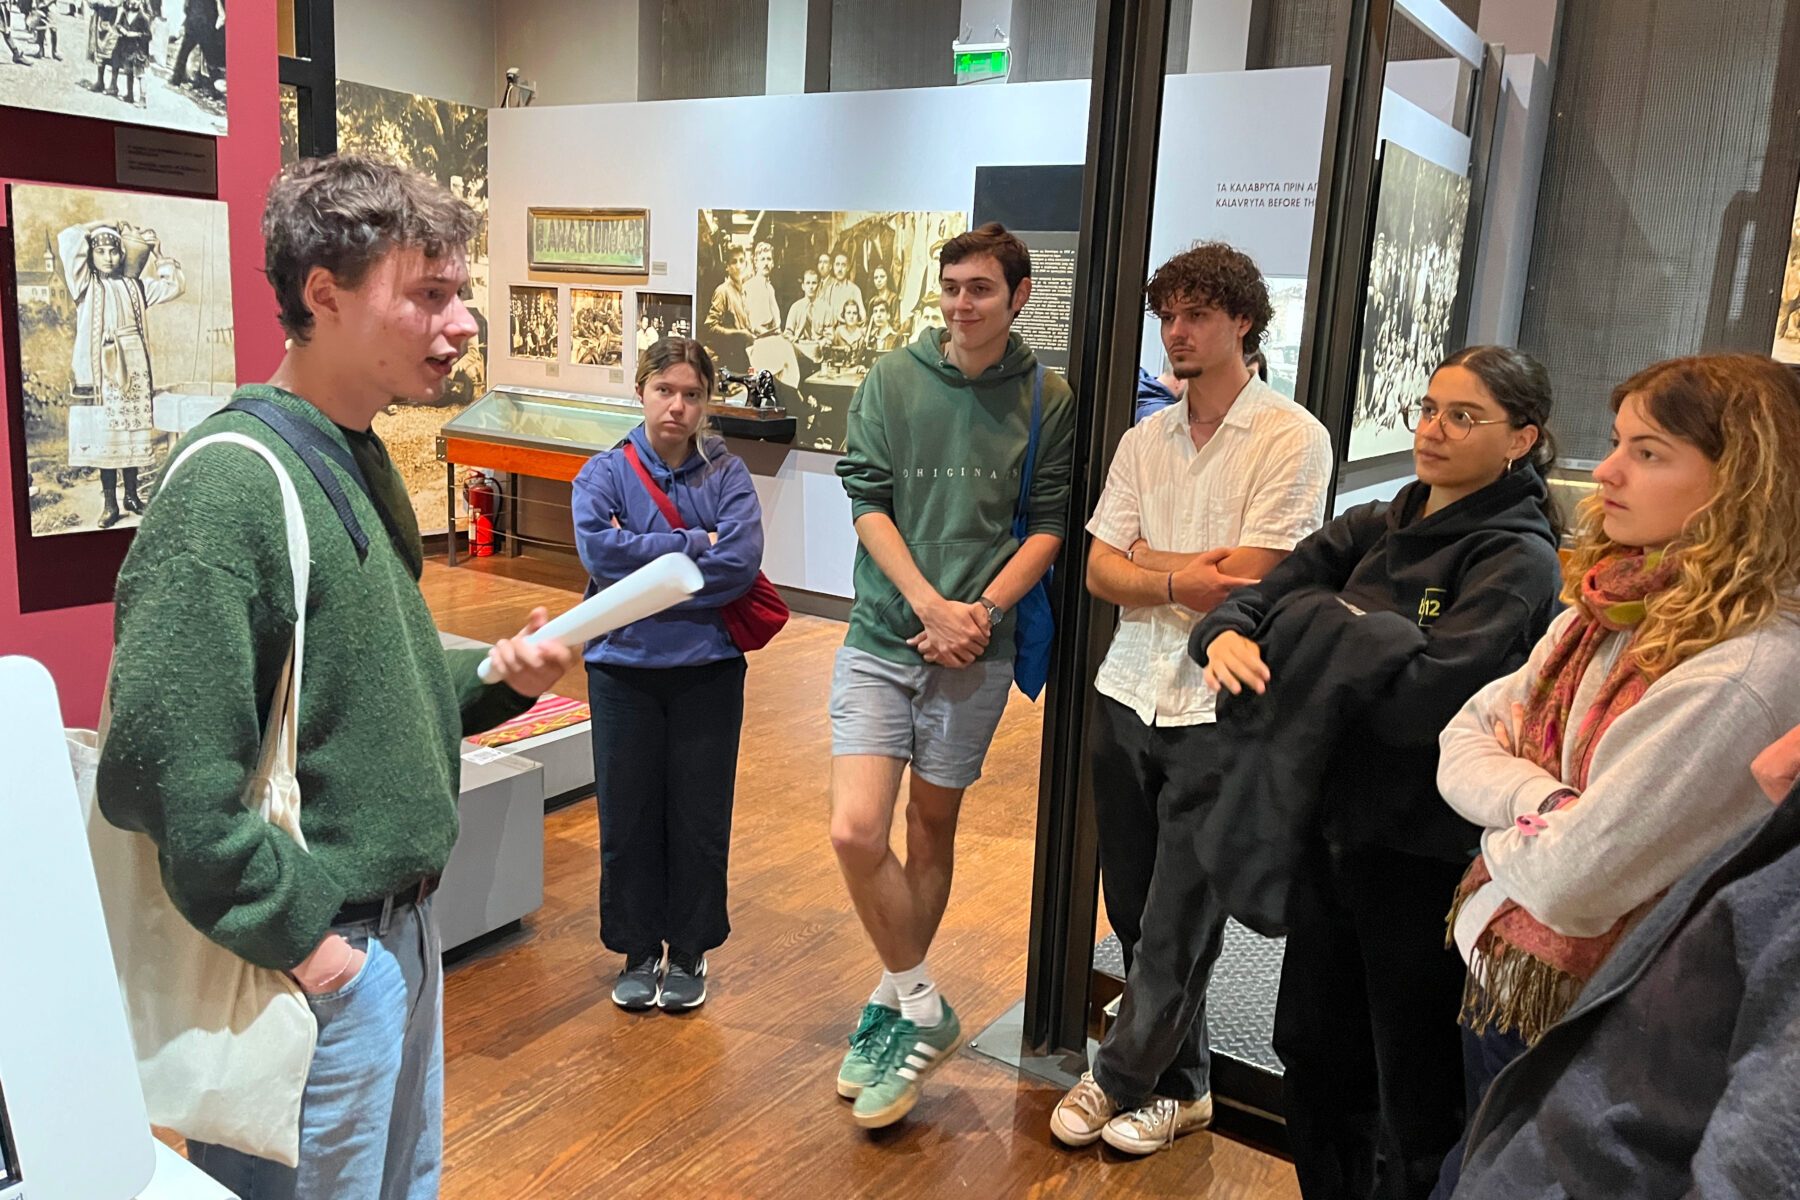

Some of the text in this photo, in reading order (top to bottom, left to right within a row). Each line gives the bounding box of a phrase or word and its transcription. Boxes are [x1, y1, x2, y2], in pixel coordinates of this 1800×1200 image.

[1217, 183, 1227, 192] ΤΑ
[1230, 183, 1280, 192] ΚΑΛΑΒΡΥΤΑ
[1283, 182, 1304, 192] ΠΡΙΝ
[1216, 198, 1265, 207] KALAVRYTA
[1268, 198, 1301, 207] BEFORE
[903, 466, 1018, 479] ORIGINAS
